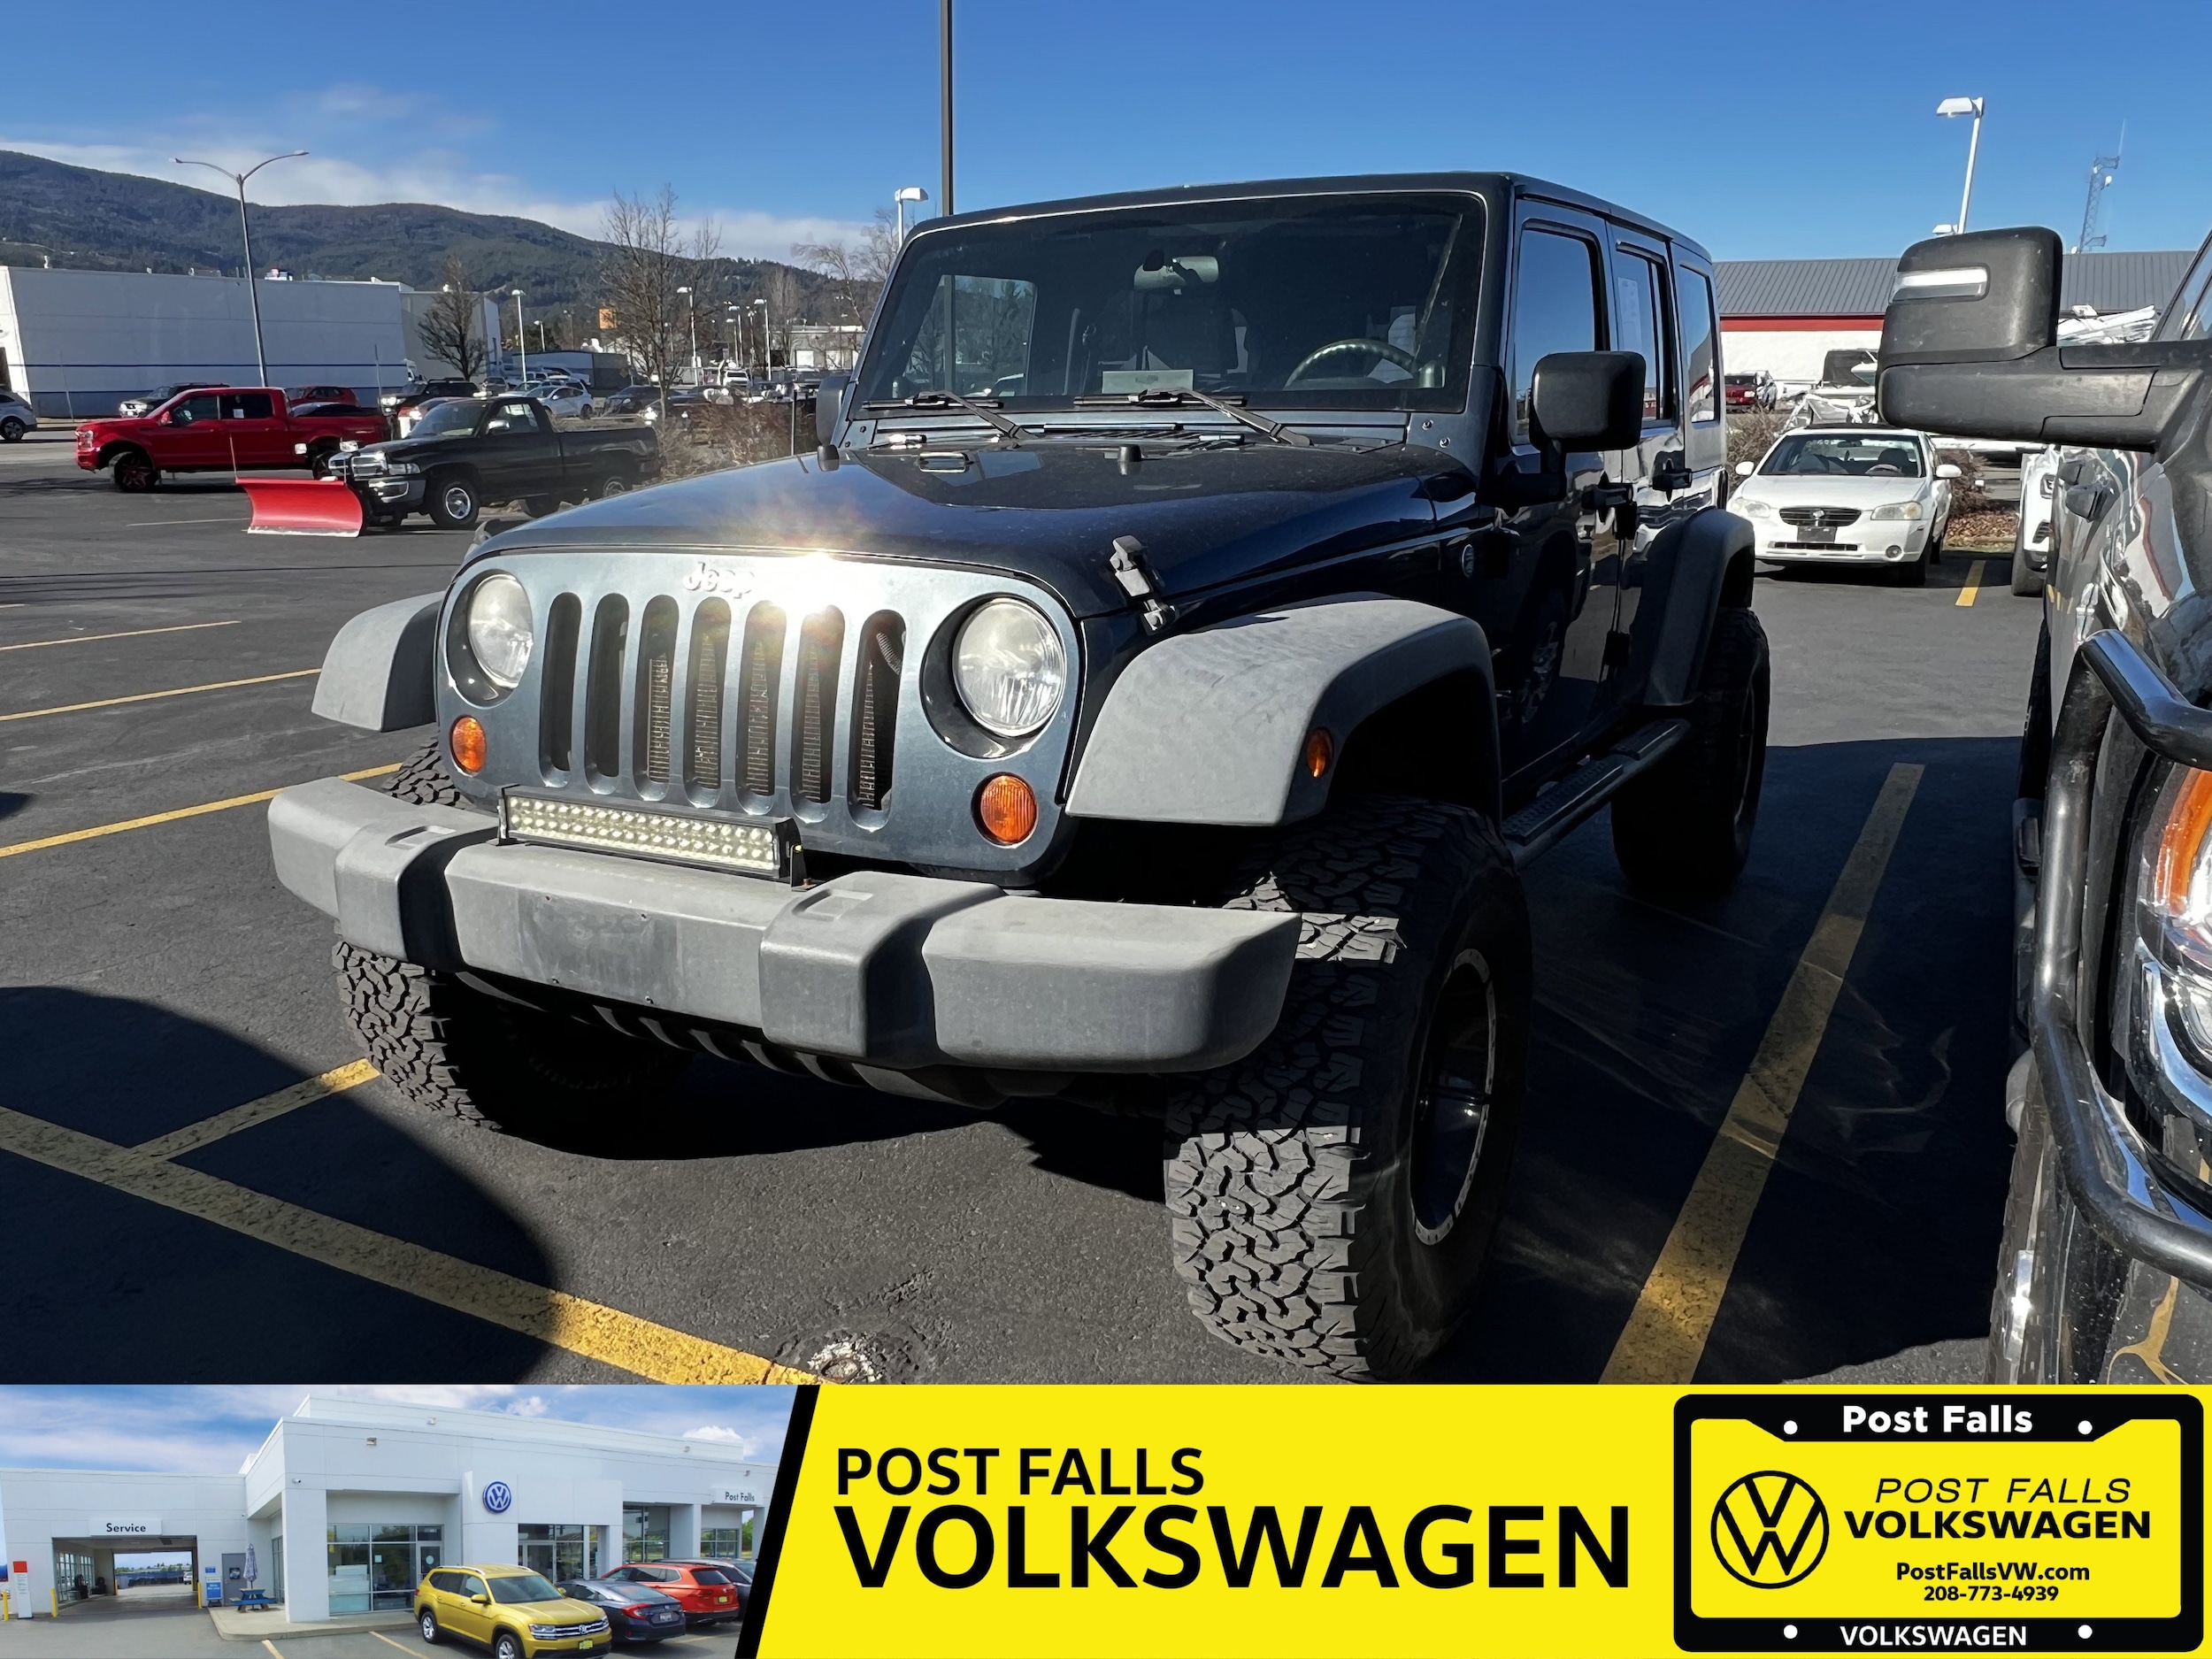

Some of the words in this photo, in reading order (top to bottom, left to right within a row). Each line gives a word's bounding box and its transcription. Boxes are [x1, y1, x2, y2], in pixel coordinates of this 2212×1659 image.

[725, 1491, 740, 1502] Post
[741, 1492, 756, 1502] Falls
[105, 1523, 147, 1533] Service
